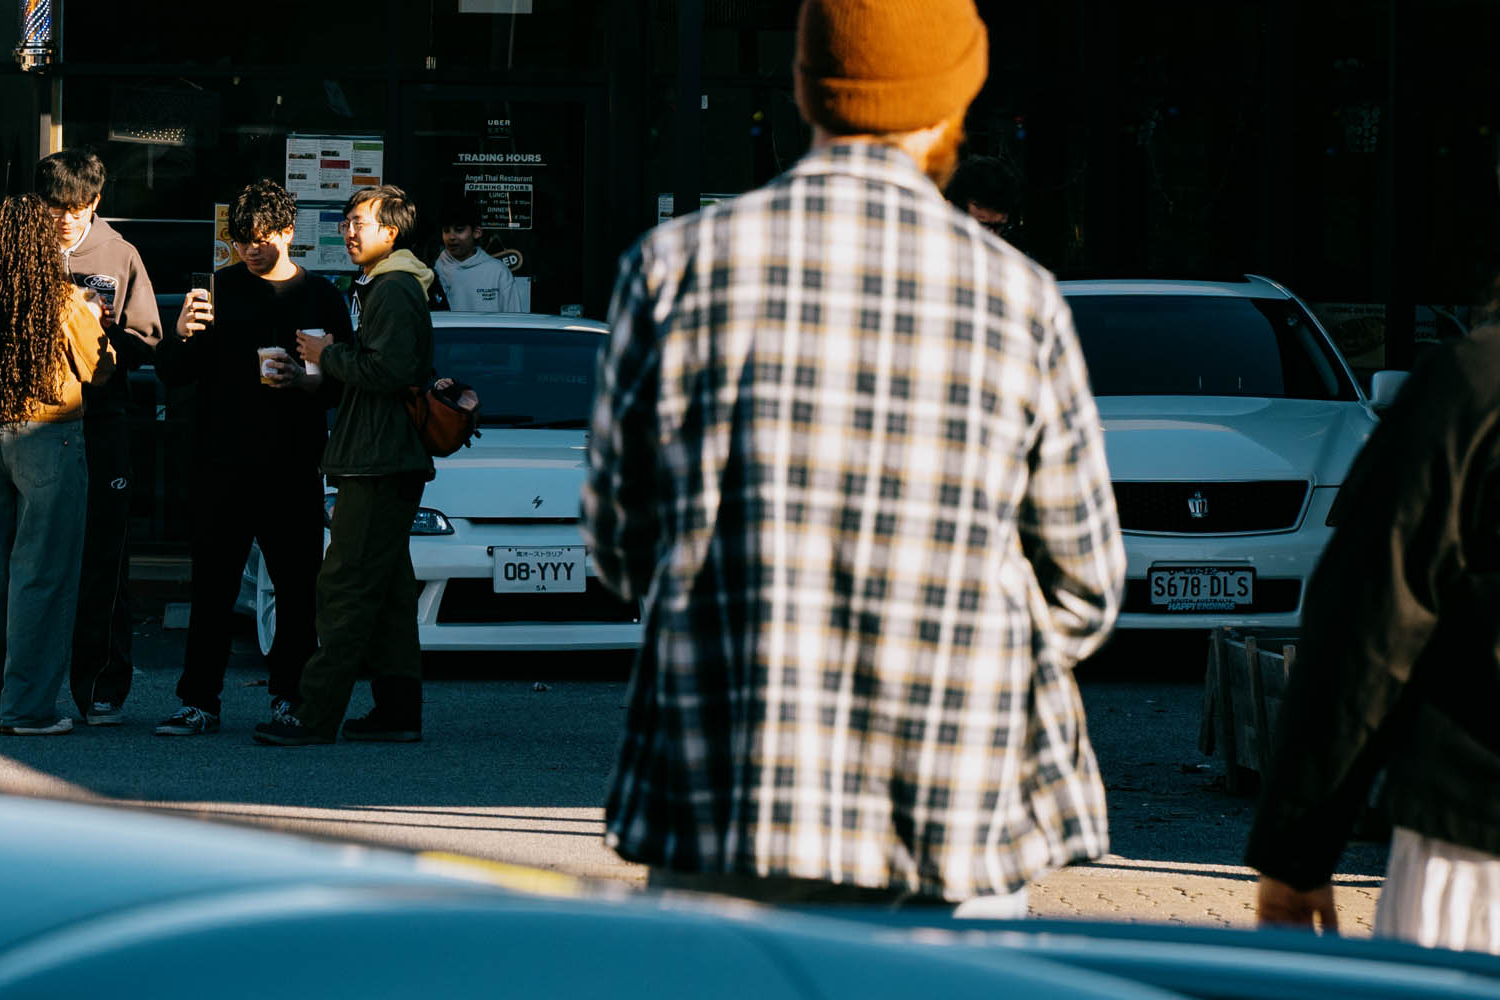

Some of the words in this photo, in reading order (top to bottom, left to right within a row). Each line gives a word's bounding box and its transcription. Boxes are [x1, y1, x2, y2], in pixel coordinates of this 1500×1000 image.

[458, 154, 503, 162] TRADING
[506, 154, 541, 162] HOURS
[465, 175, 483, 183] Angel
[91, 276, 115, 287] Ford
[504, 562, 575, 581] 08-YYY
